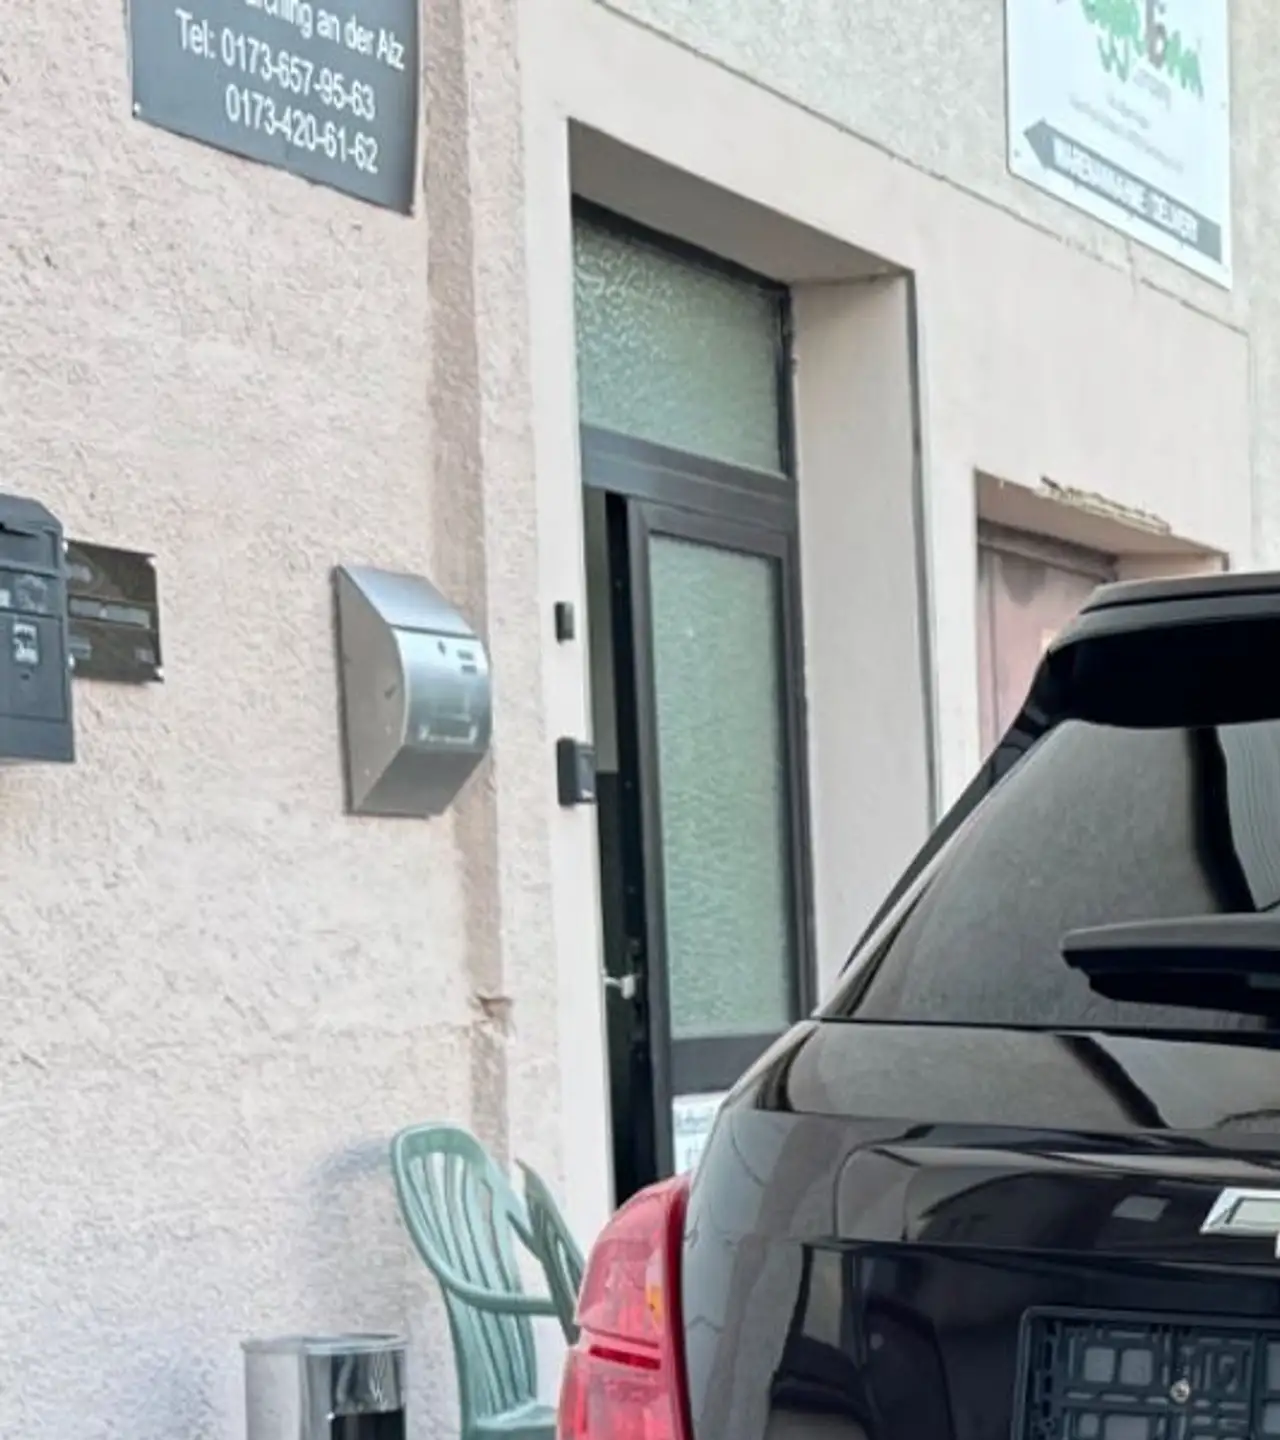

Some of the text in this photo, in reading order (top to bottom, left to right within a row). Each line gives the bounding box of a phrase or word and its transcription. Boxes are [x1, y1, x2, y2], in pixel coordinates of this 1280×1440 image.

[175, 8, 376, 121] Tel: 0173-657-95-63
[316, 8, 341, 44] an
[343, 13, 375, 56] der
[225, 83, 379, 174] 0173-420-61-62
